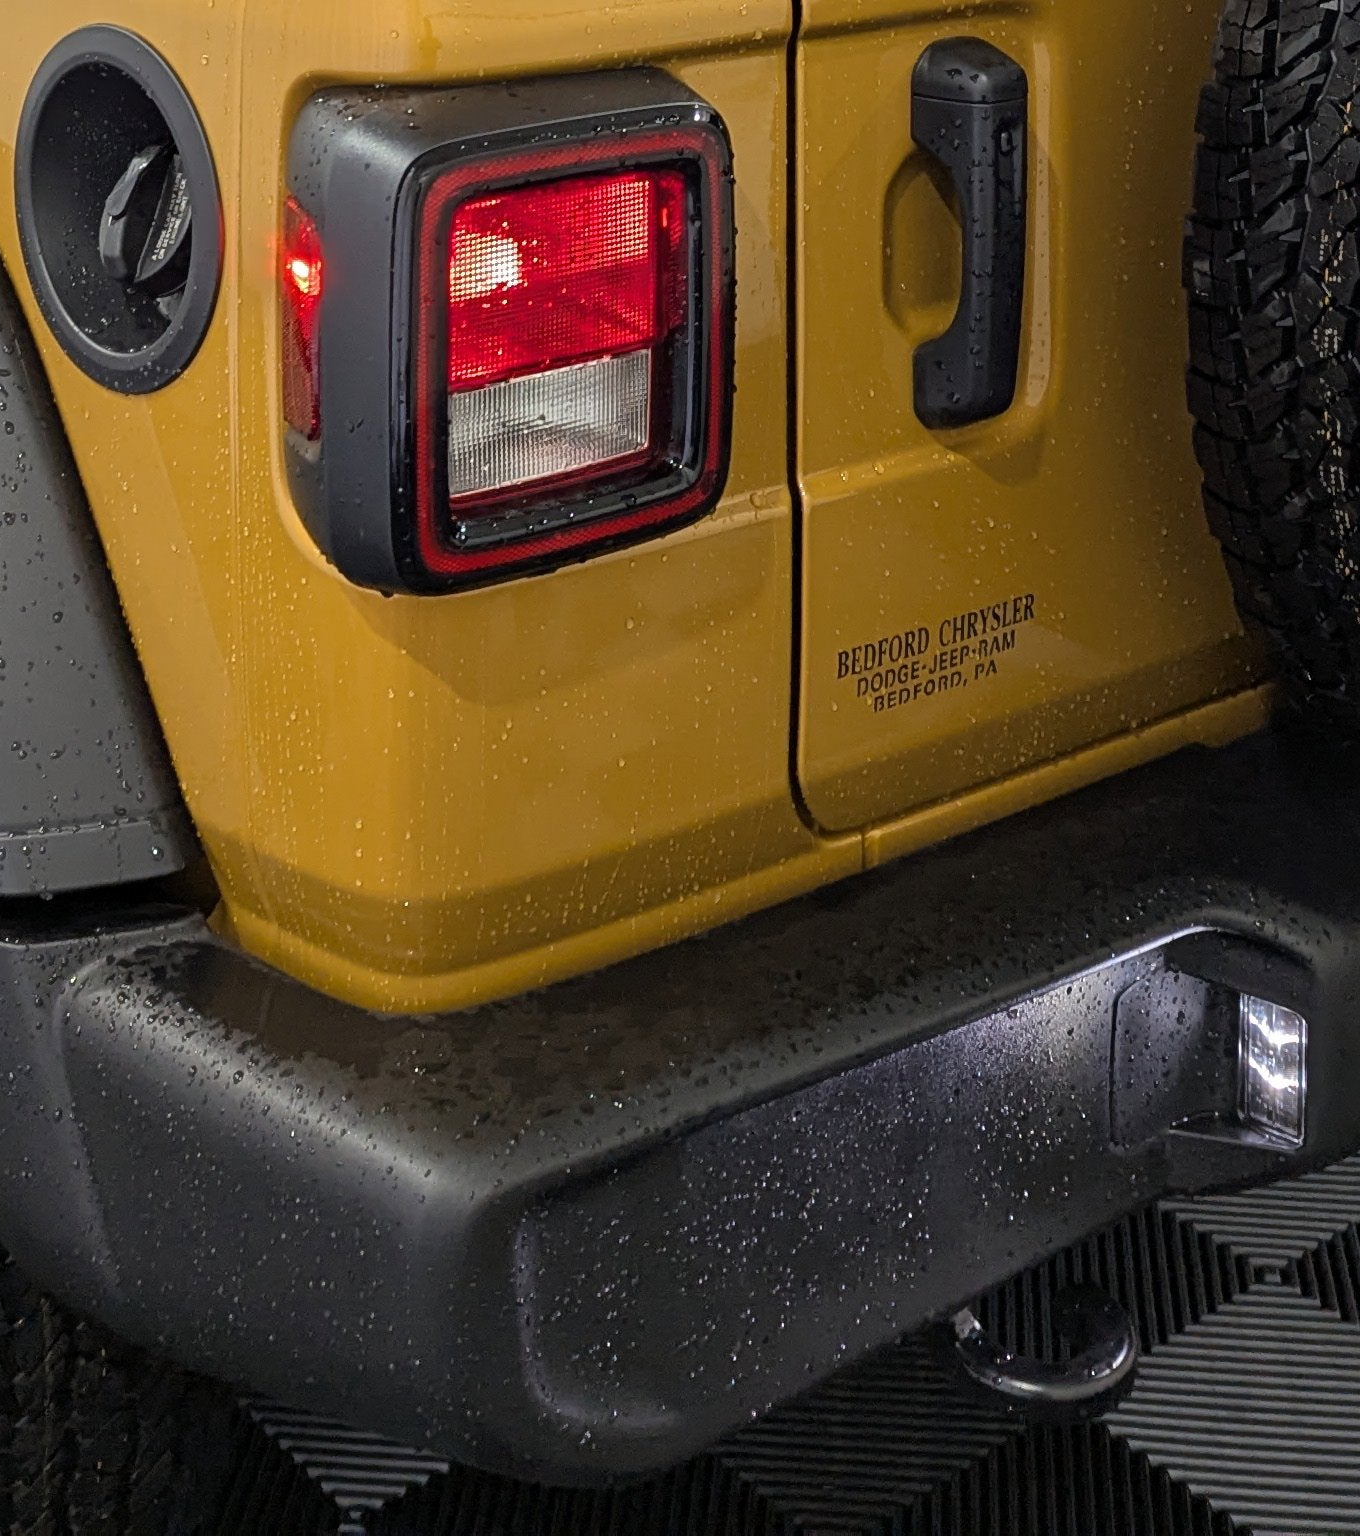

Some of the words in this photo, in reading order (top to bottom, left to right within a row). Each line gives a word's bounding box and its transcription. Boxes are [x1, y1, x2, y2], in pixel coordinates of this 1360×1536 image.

[837, 627, 930, 679] BEDFORD
[939, 593, 1036, 648] CHRYSLER
[873, 671, 968, 713] BEDFORD,
[974, 659, 998, 681] PA
